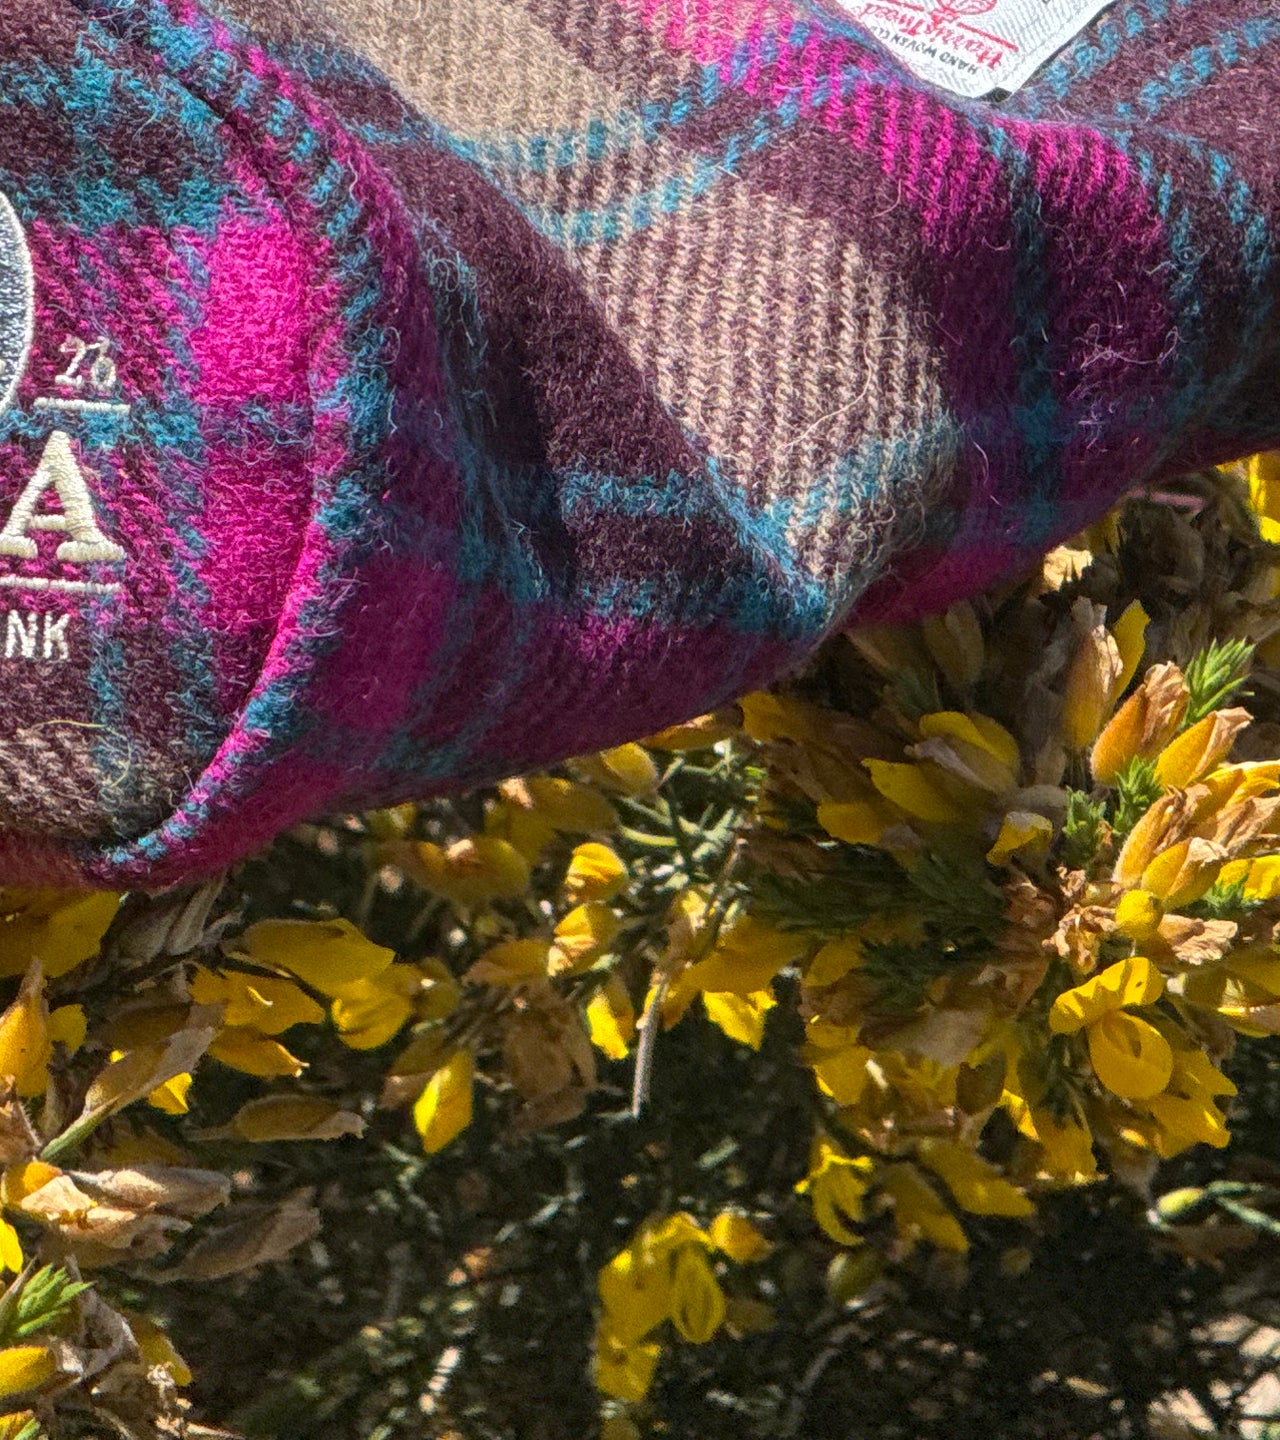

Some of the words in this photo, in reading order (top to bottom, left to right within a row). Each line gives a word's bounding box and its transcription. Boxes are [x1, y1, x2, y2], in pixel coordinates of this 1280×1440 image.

[858, 3, 925, 36] Tweed
[923, 22, 1003, 70] Harris
[939, 52, 978, 75] HAND
